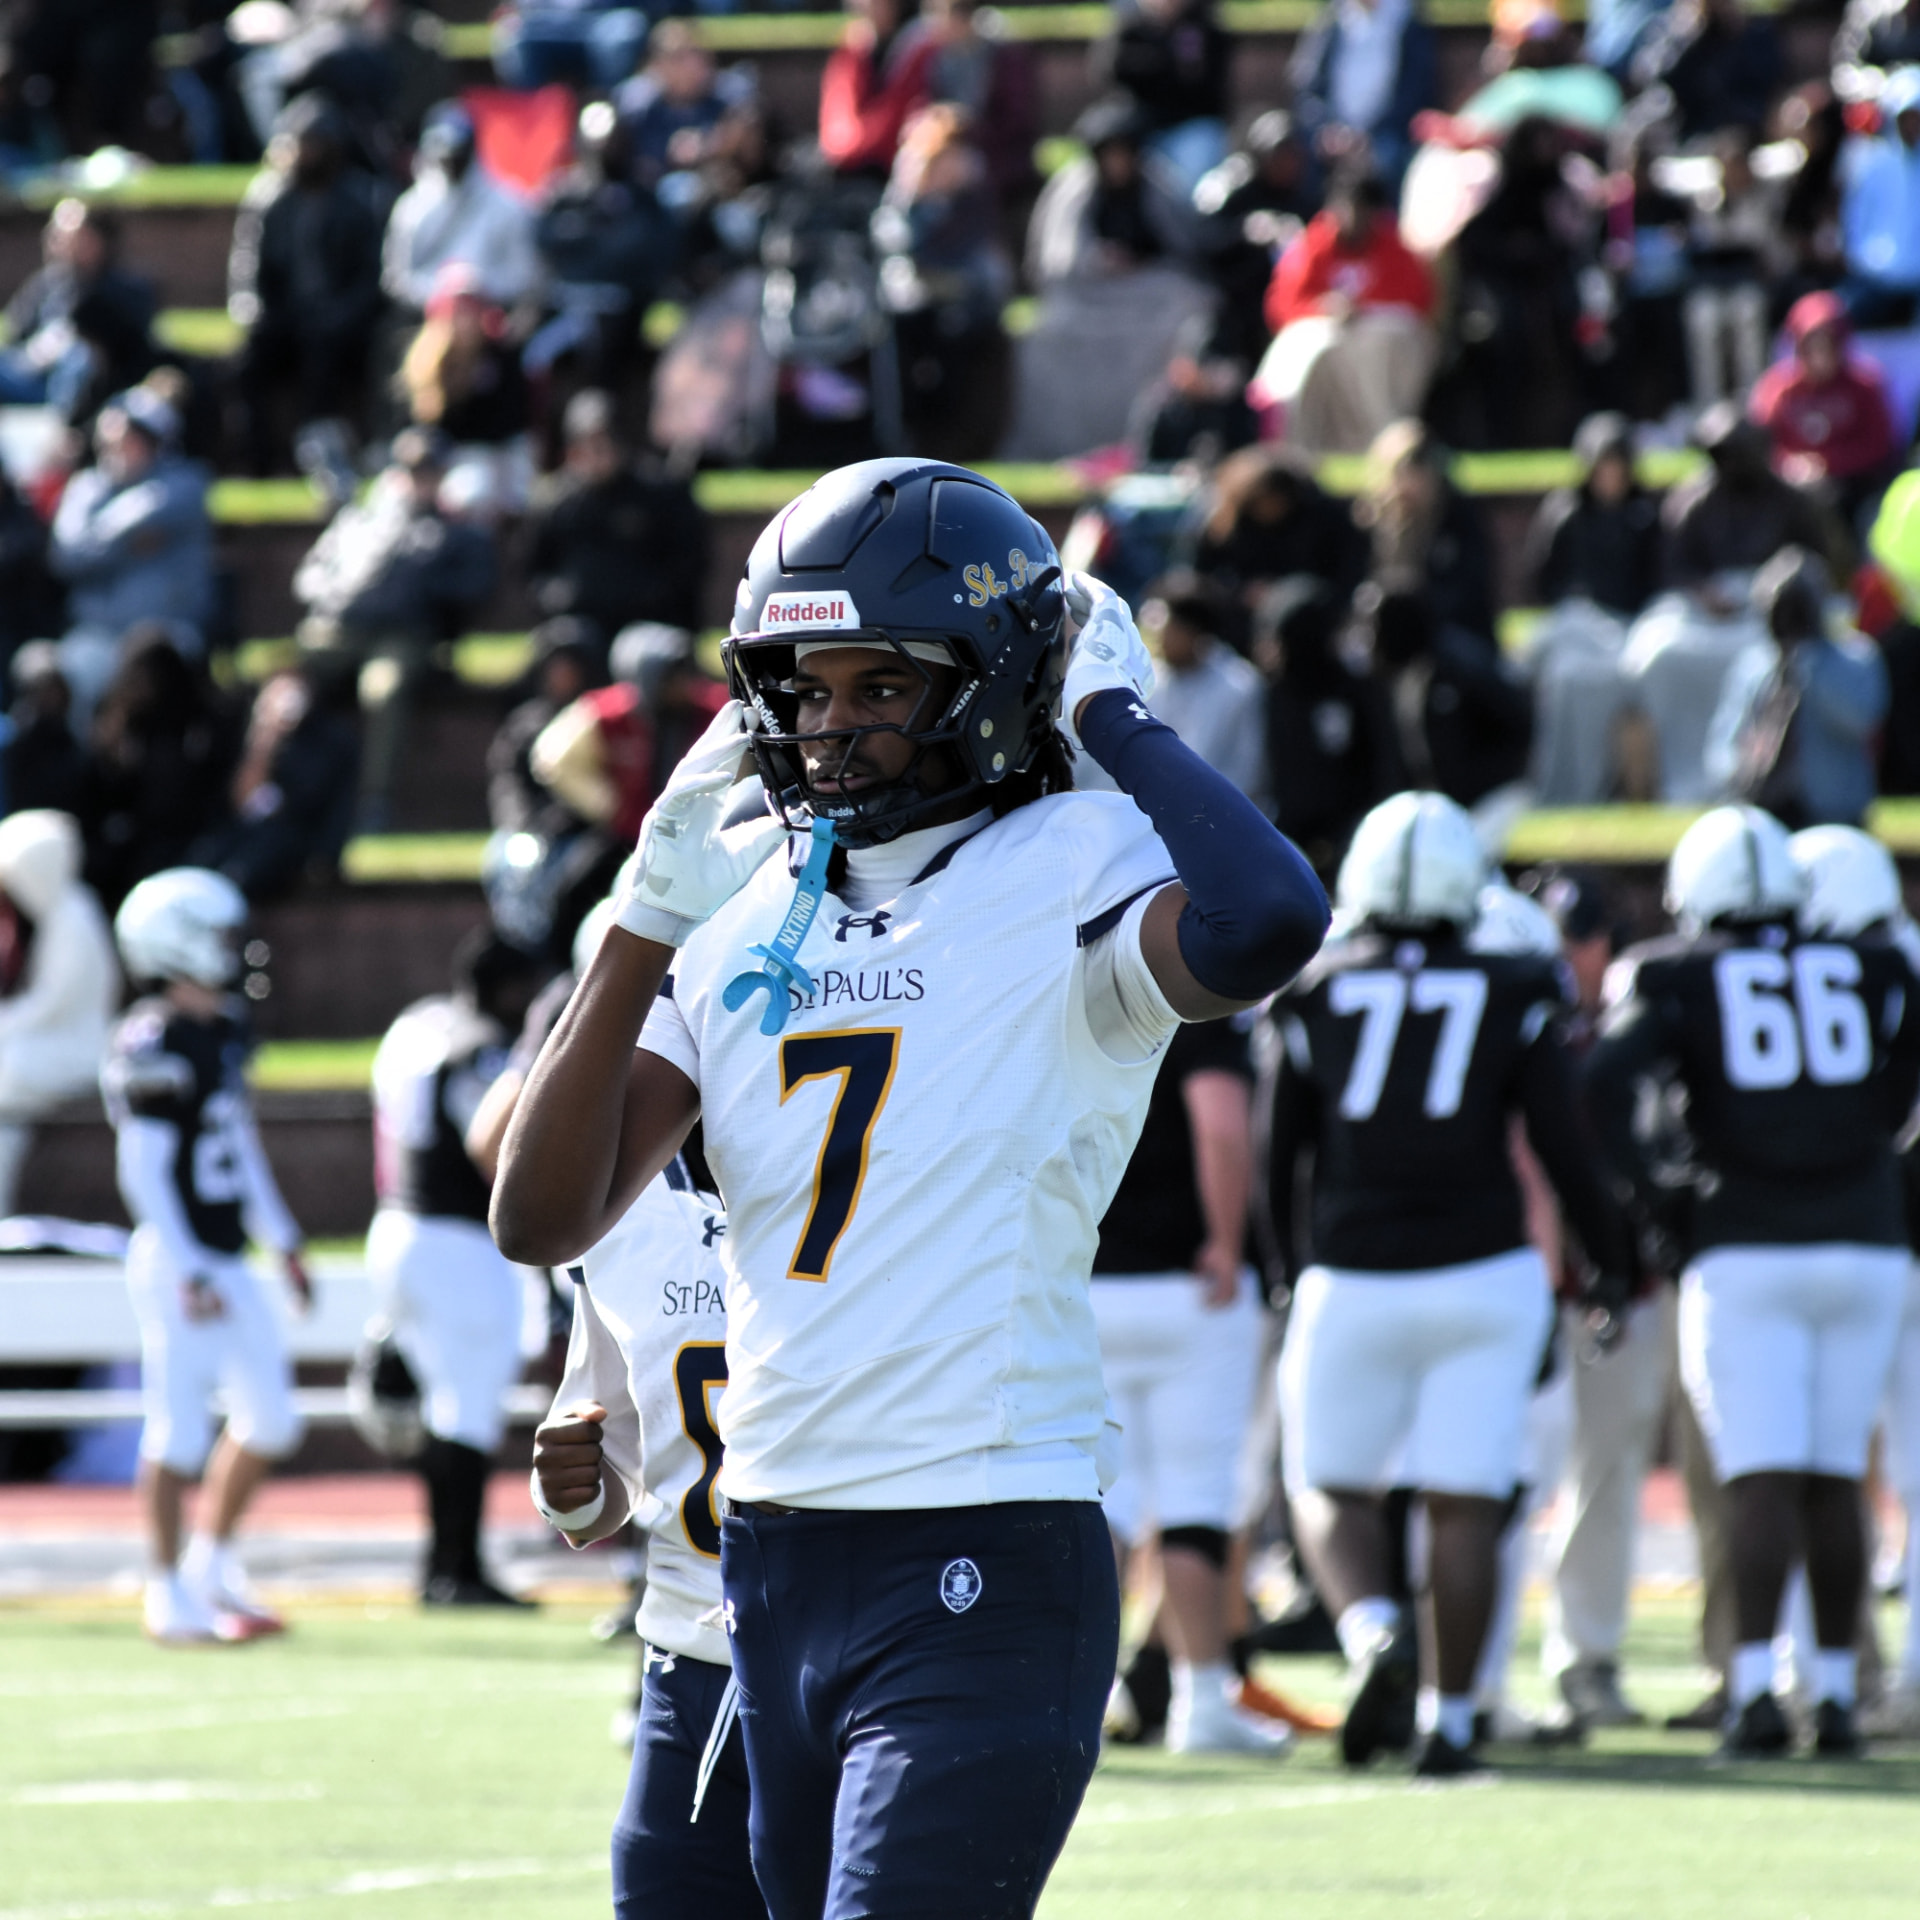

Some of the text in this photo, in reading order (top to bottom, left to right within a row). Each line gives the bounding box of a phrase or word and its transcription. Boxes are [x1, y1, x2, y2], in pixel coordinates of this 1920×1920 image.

[963, 562, 1008, 607] St.
[768, 601, 845, 622] Riddell
[755, 693, 787, 737] Ridde
[828, 805, 863, 818] Riddel
[777, 890, 816, 950] NXTRND
[1714, 944, 1873, 1090] 66
[1328, 968, 1489, 1120] 77
[778, 1026, 903, 1283] 7
